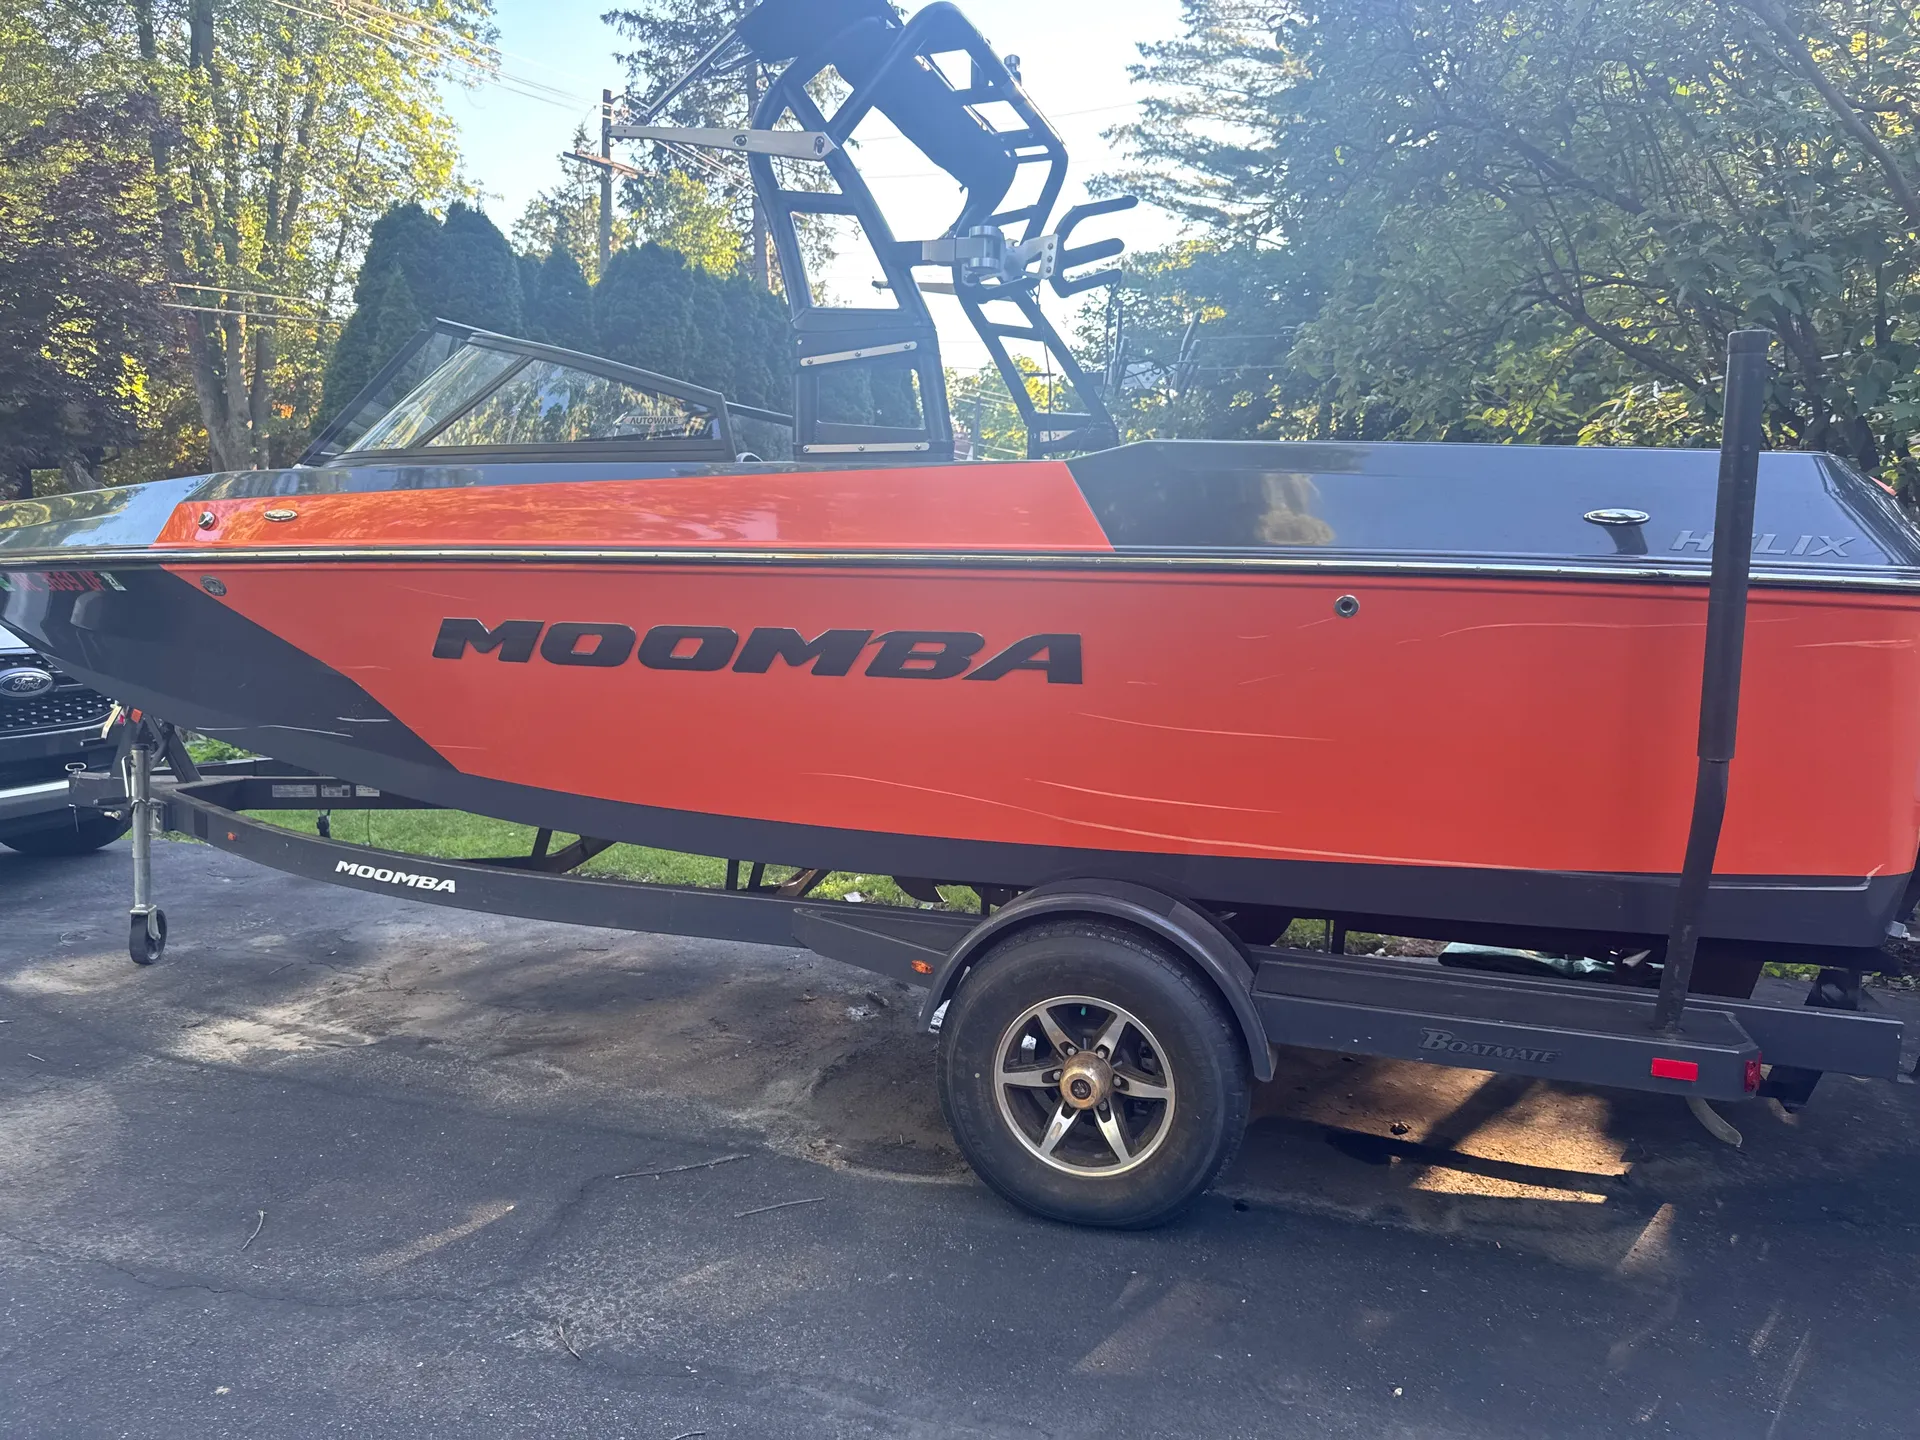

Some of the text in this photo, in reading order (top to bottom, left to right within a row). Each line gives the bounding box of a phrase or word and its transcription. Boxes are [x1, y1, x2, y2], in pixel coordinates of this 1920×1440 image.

[629, 416, 679, 425] AUTOWAKE
[1669, 530, 1856, 557] HLIX
[431, 616, 1083, 685] MOOMBA
[12, 677, 41, 691] Ford
[335, 860, 456, 893] MOOMBA
